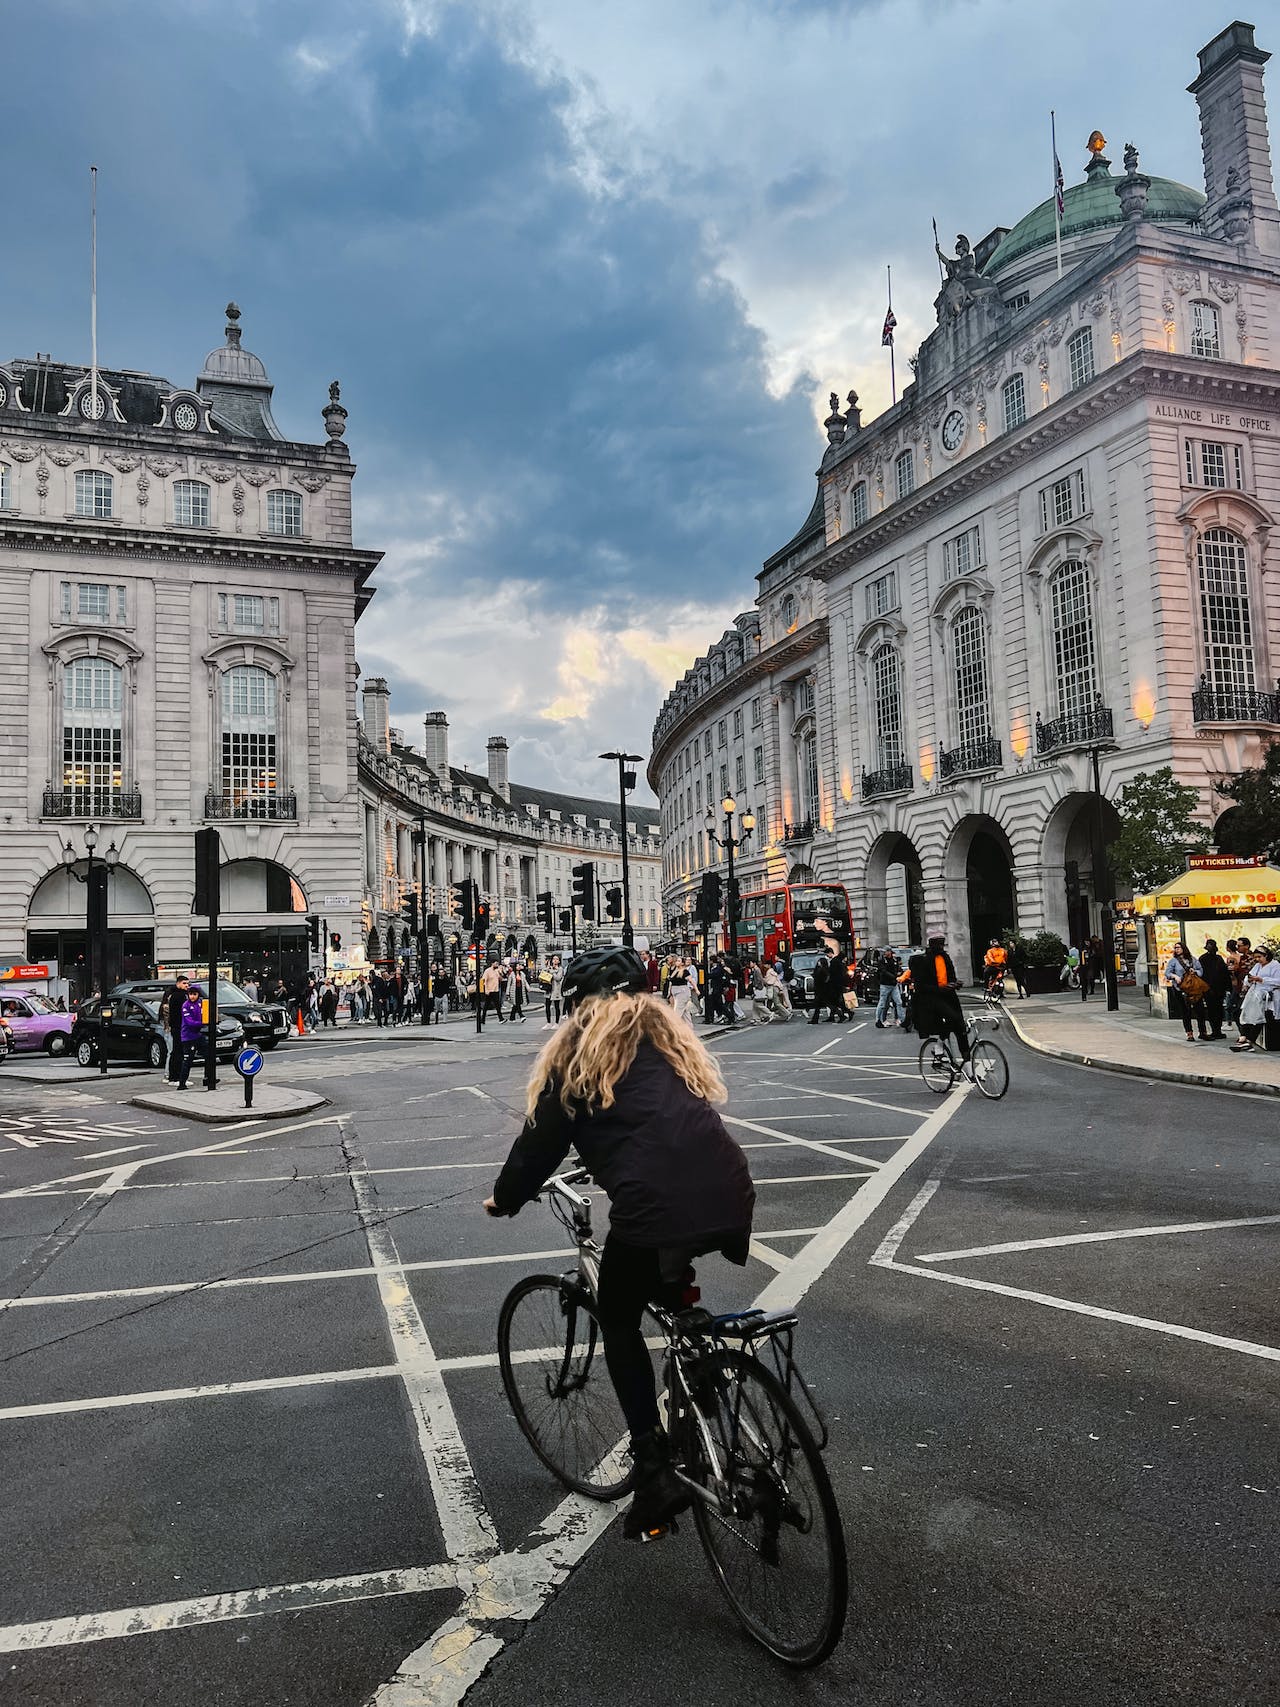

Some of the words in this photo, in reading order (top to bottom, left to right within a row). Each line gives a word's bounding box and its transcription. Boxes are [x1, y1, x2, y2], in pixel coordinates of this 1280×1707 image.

[1155, 405, 1202, 421] ALLIANCE
[1211, 413, 1231, 425] LIFE
[1240, 417, 1271, 431] OFFICE
[1205, 858, 1235, 866] TICKETS
[1235, 857, 1255, 865] HERE
[1210, 895, 1240, 905] HOT
[1246, 893, 1277, 903] DOG
[832, 919, 843, 928] 139
[0, 1121, 189, 1151] ANE
